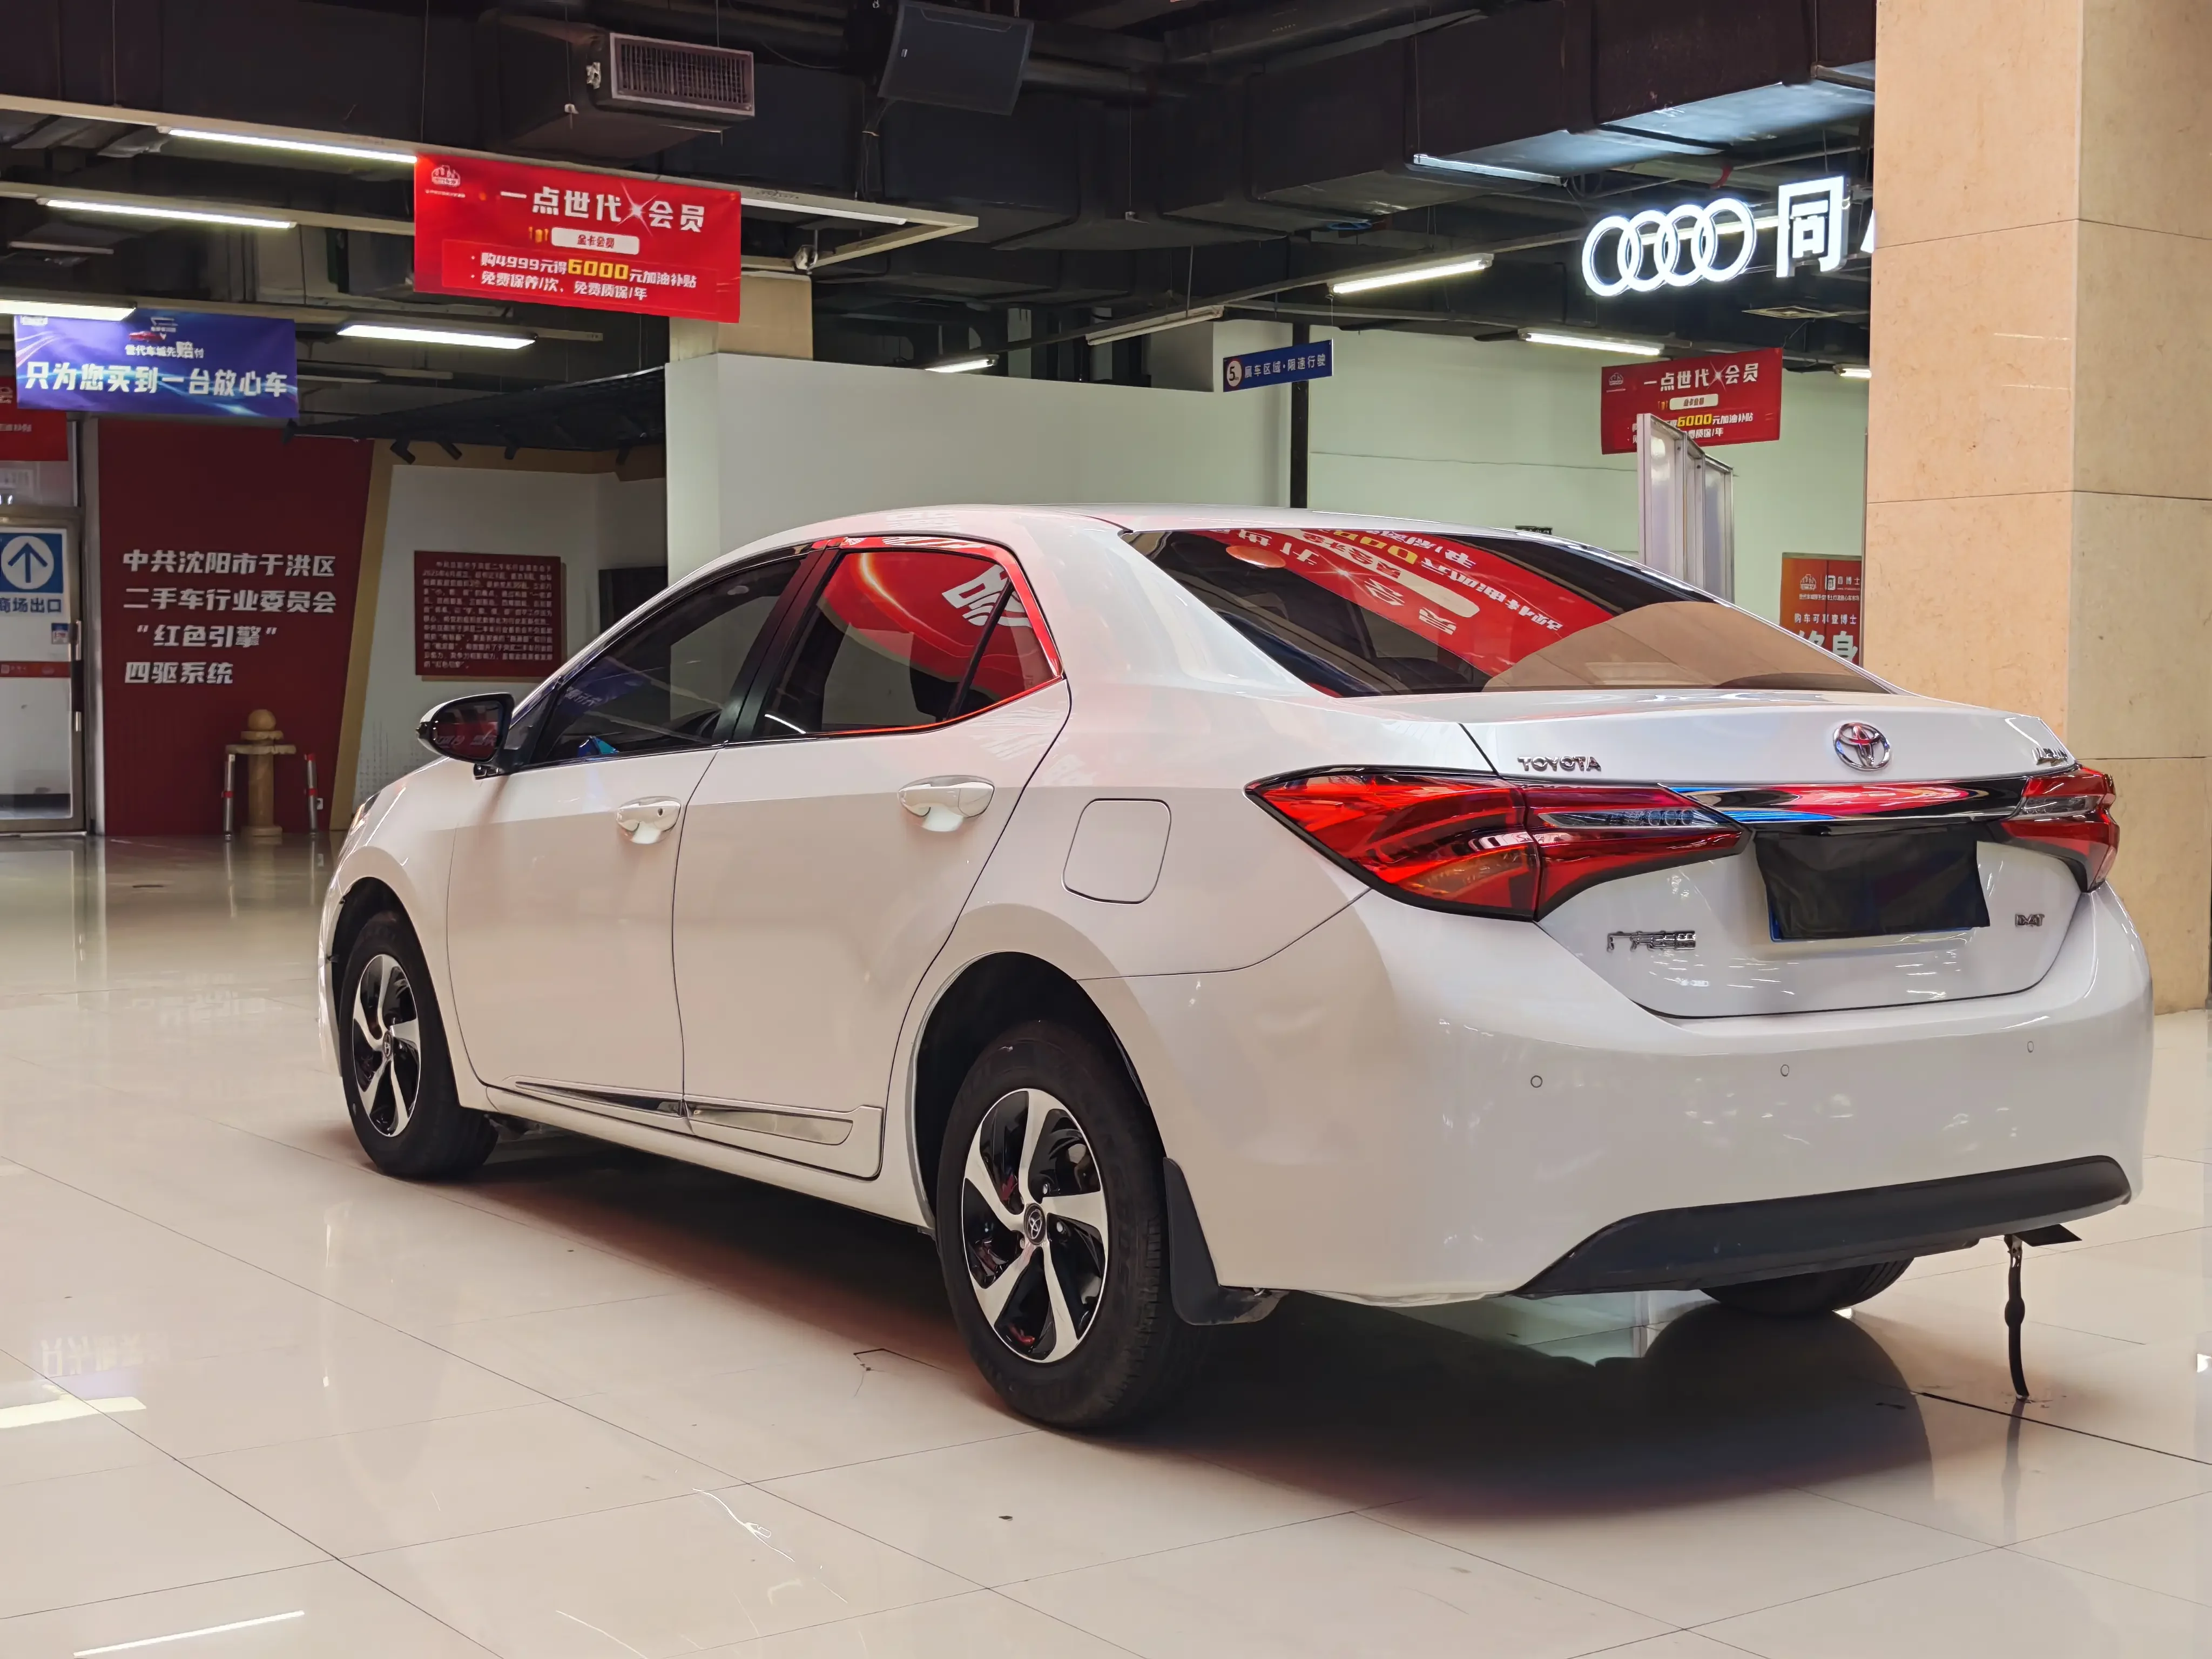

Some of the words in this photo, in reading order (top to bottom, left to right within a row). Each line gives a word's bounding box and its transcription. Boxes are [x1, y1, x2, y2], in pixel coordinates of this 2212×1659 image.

[501, 186, 622, 222] 一点世代
[649, 201, 705, 232] 会员
[1776, 176, 1873, 278] 同
[25, 361, 287, 397] 只为您买到一台放心车
[1644, 368, 1710, 392] 一点世代
[1725, 363, 1759, 385] 会员
[123, 550, 336, 577] 中共沈阳市于洪区
[0, 597, 62, 613] 商场出口
[123, 588, 336, 613] 二手车行业委员会
[125, 662, 233, 684] 四驱系统
[1518, 756, 1602, 772] TOYOTA
